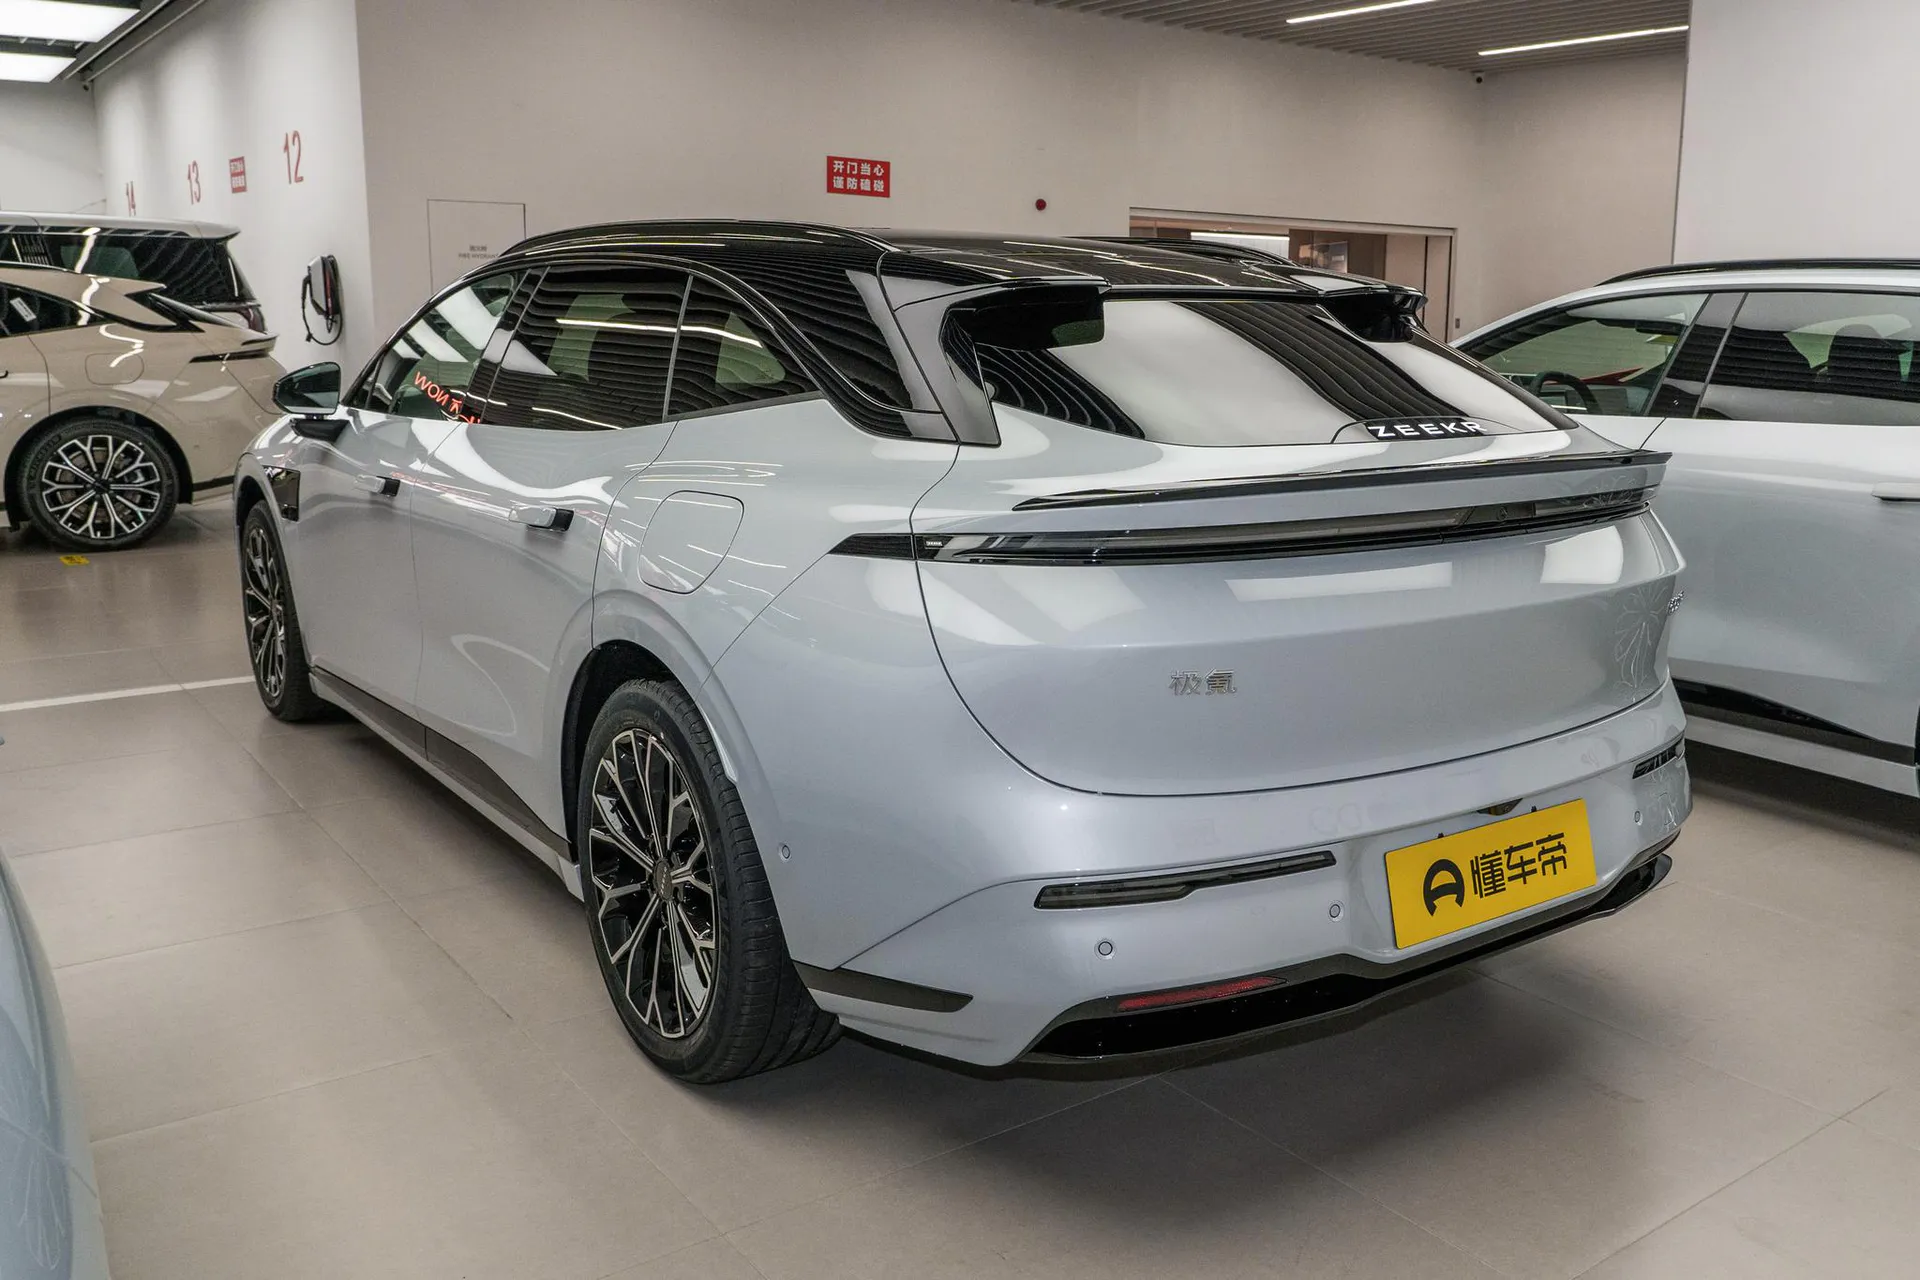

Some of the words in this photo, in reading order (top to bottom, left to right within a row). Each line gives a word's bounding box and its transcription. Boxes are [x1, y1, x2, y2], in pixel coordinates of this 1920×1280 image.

[283, 130, 305, 185] 12
[833, 160, 885, 176] 开门当心
[187, 160, 201, 205] 13
[1367, 421, 1487, 438] ZEEKR
[1168, 667, 1238, 697] 极氪
[1470, 832, 1568, 899] 懂车帝
